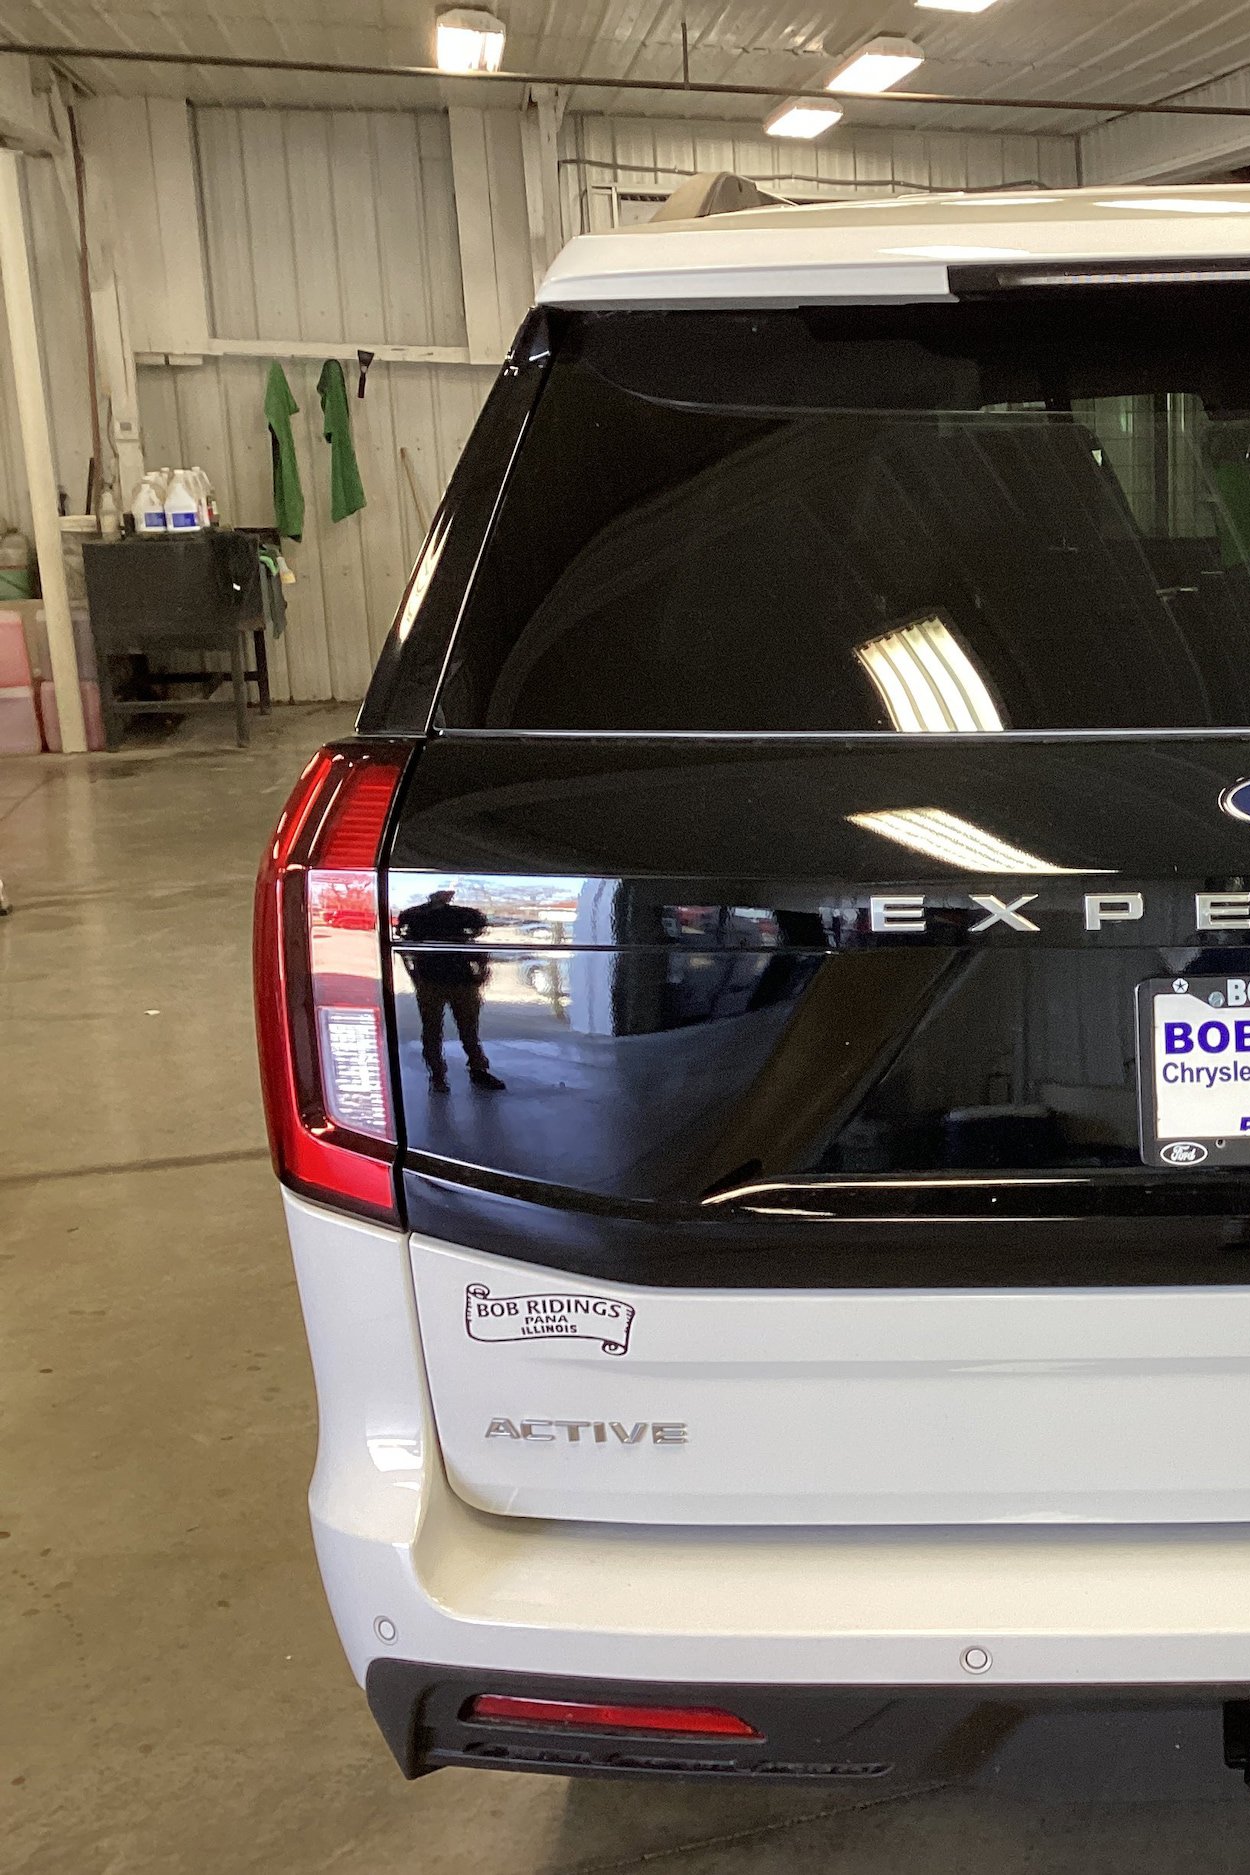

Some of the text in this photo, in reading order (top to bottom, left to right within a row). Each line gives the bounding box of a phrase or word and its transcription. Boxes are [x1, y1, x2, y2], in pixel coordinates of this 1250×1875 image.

[476, 1299, 622, 1318] BOB RIDINGS
[524, 1315, 568, 1324] PANA
[521, 1324, 578, 1335] ILLINOIS
[484, 1417, 689, 1444] ACTIVE
